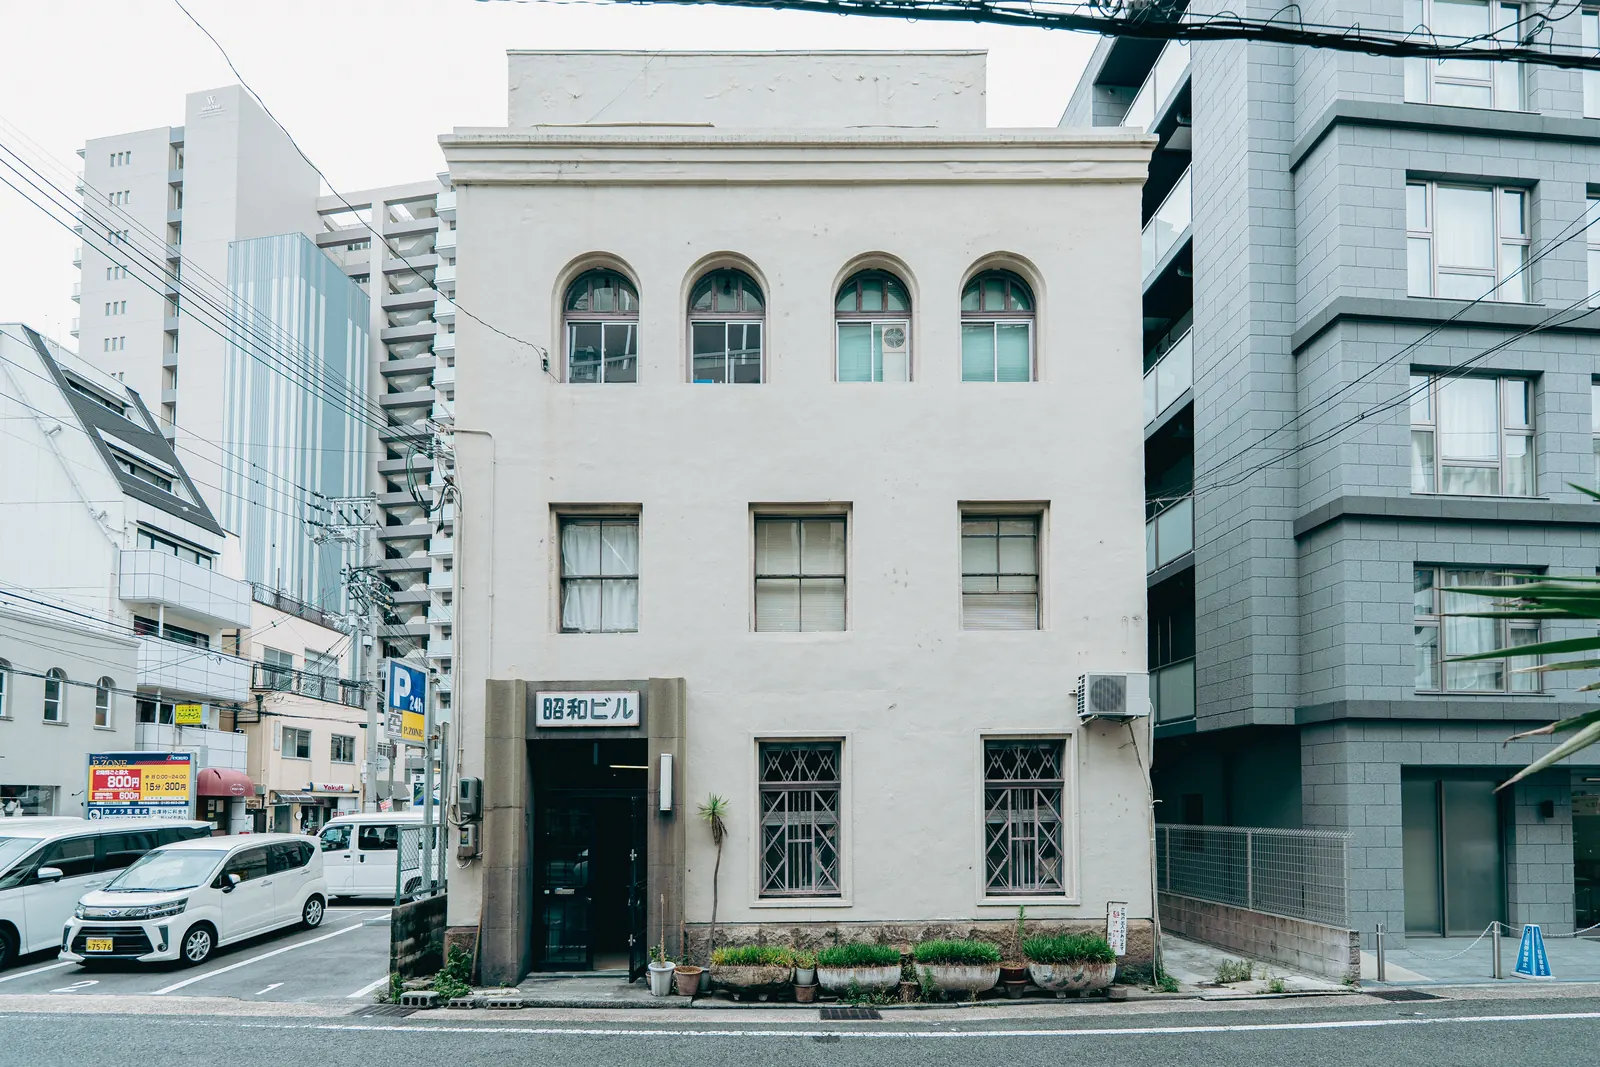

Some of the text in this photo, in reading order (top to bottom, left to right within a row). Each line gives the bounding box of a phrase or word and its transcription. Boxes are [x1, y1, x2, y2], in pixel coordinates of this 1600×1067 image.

[393, 666, 411, 707] P
[409, 695, 424, 713] 24h
[543, 697, 634, 720] 昭和ビル
[403, 726, 424, 738] P.ZONE
[92, 760, 128, 768] P.ZONE
[107, 776, 140, 788] 800円
[119, 791, 140, 800] 600円
[49, 980, 99, 992] 2
[255, 982, 285, 995] 1
